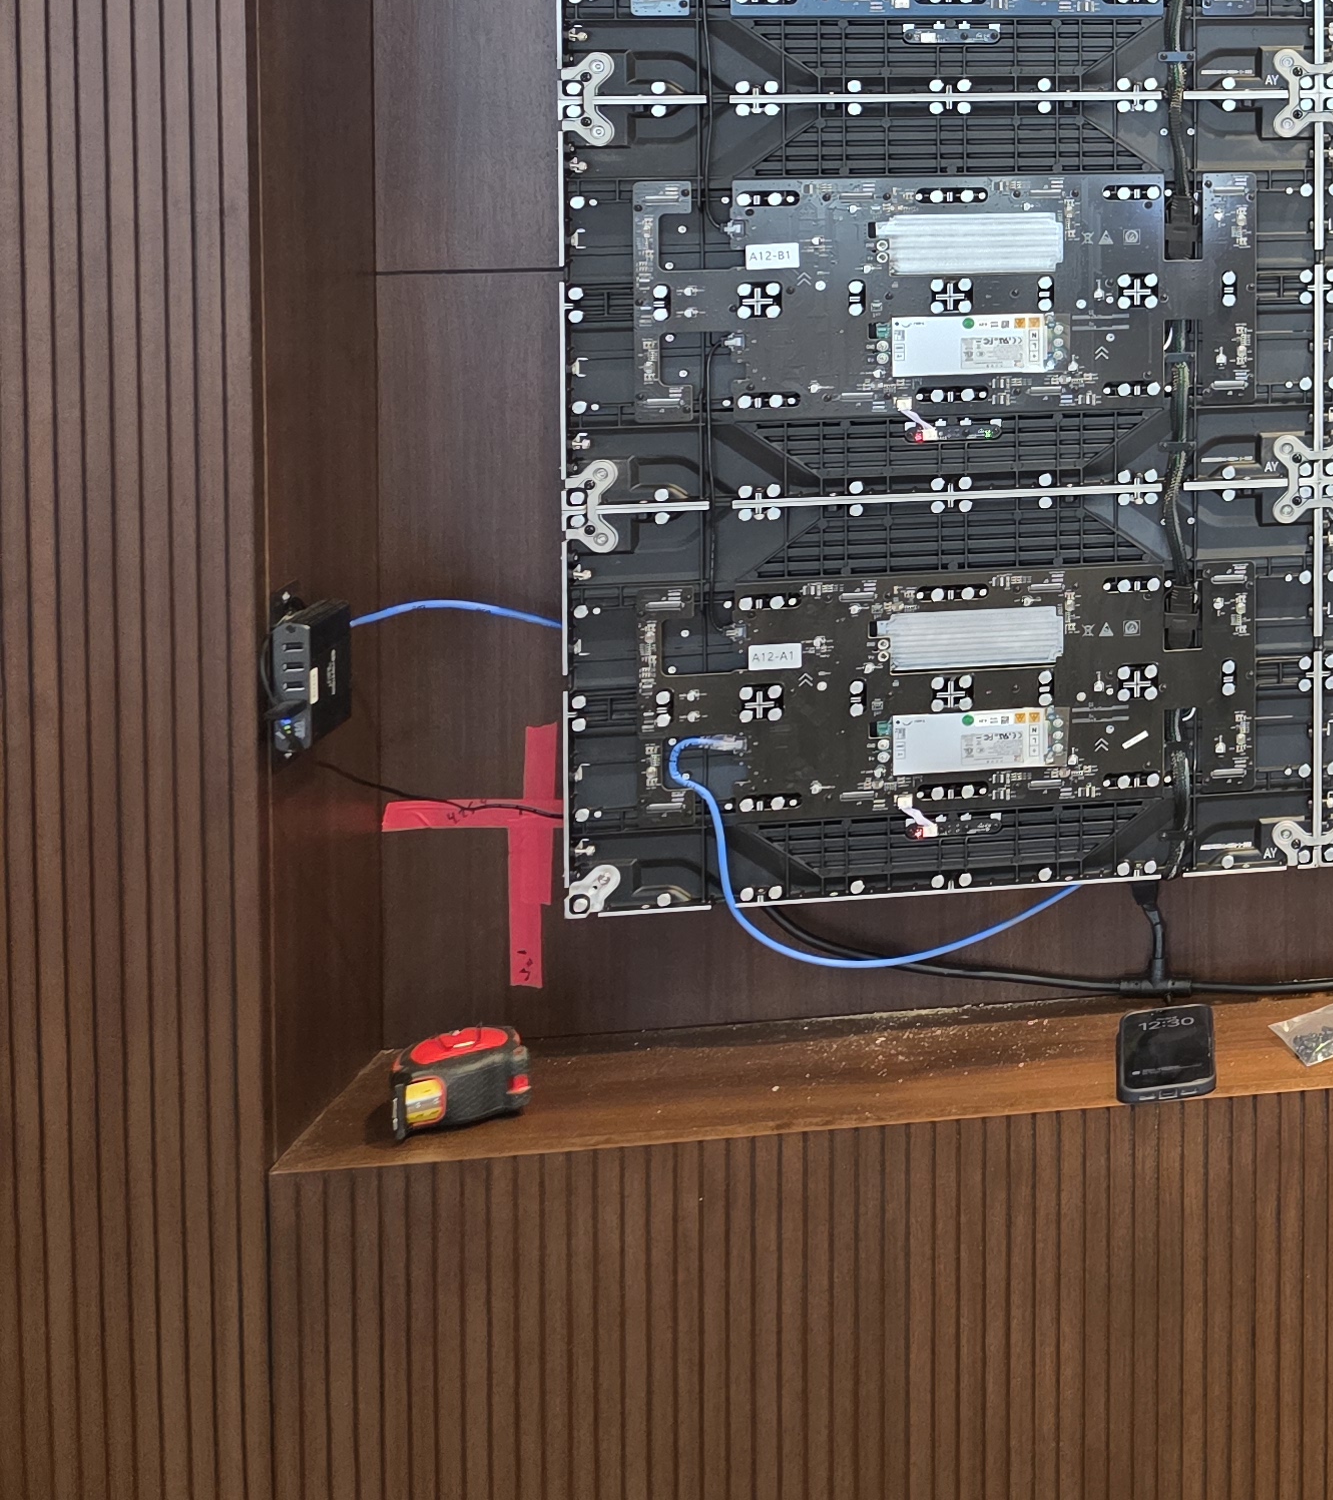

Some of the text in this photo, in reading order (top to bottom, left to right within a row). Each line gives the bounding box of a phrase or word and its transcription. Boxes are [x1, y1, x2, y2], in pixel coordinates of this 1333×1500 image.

[1264, 75, 1279, 85] AY
[749, 250, 790, 261] A12-B1
[1264, 462, 1279, 472] AY
[751, 650, 794, 662] A12-A1
[1263, 848, 1278, 859] AY
[1138, 1017, 1195, 1031] 12:30
